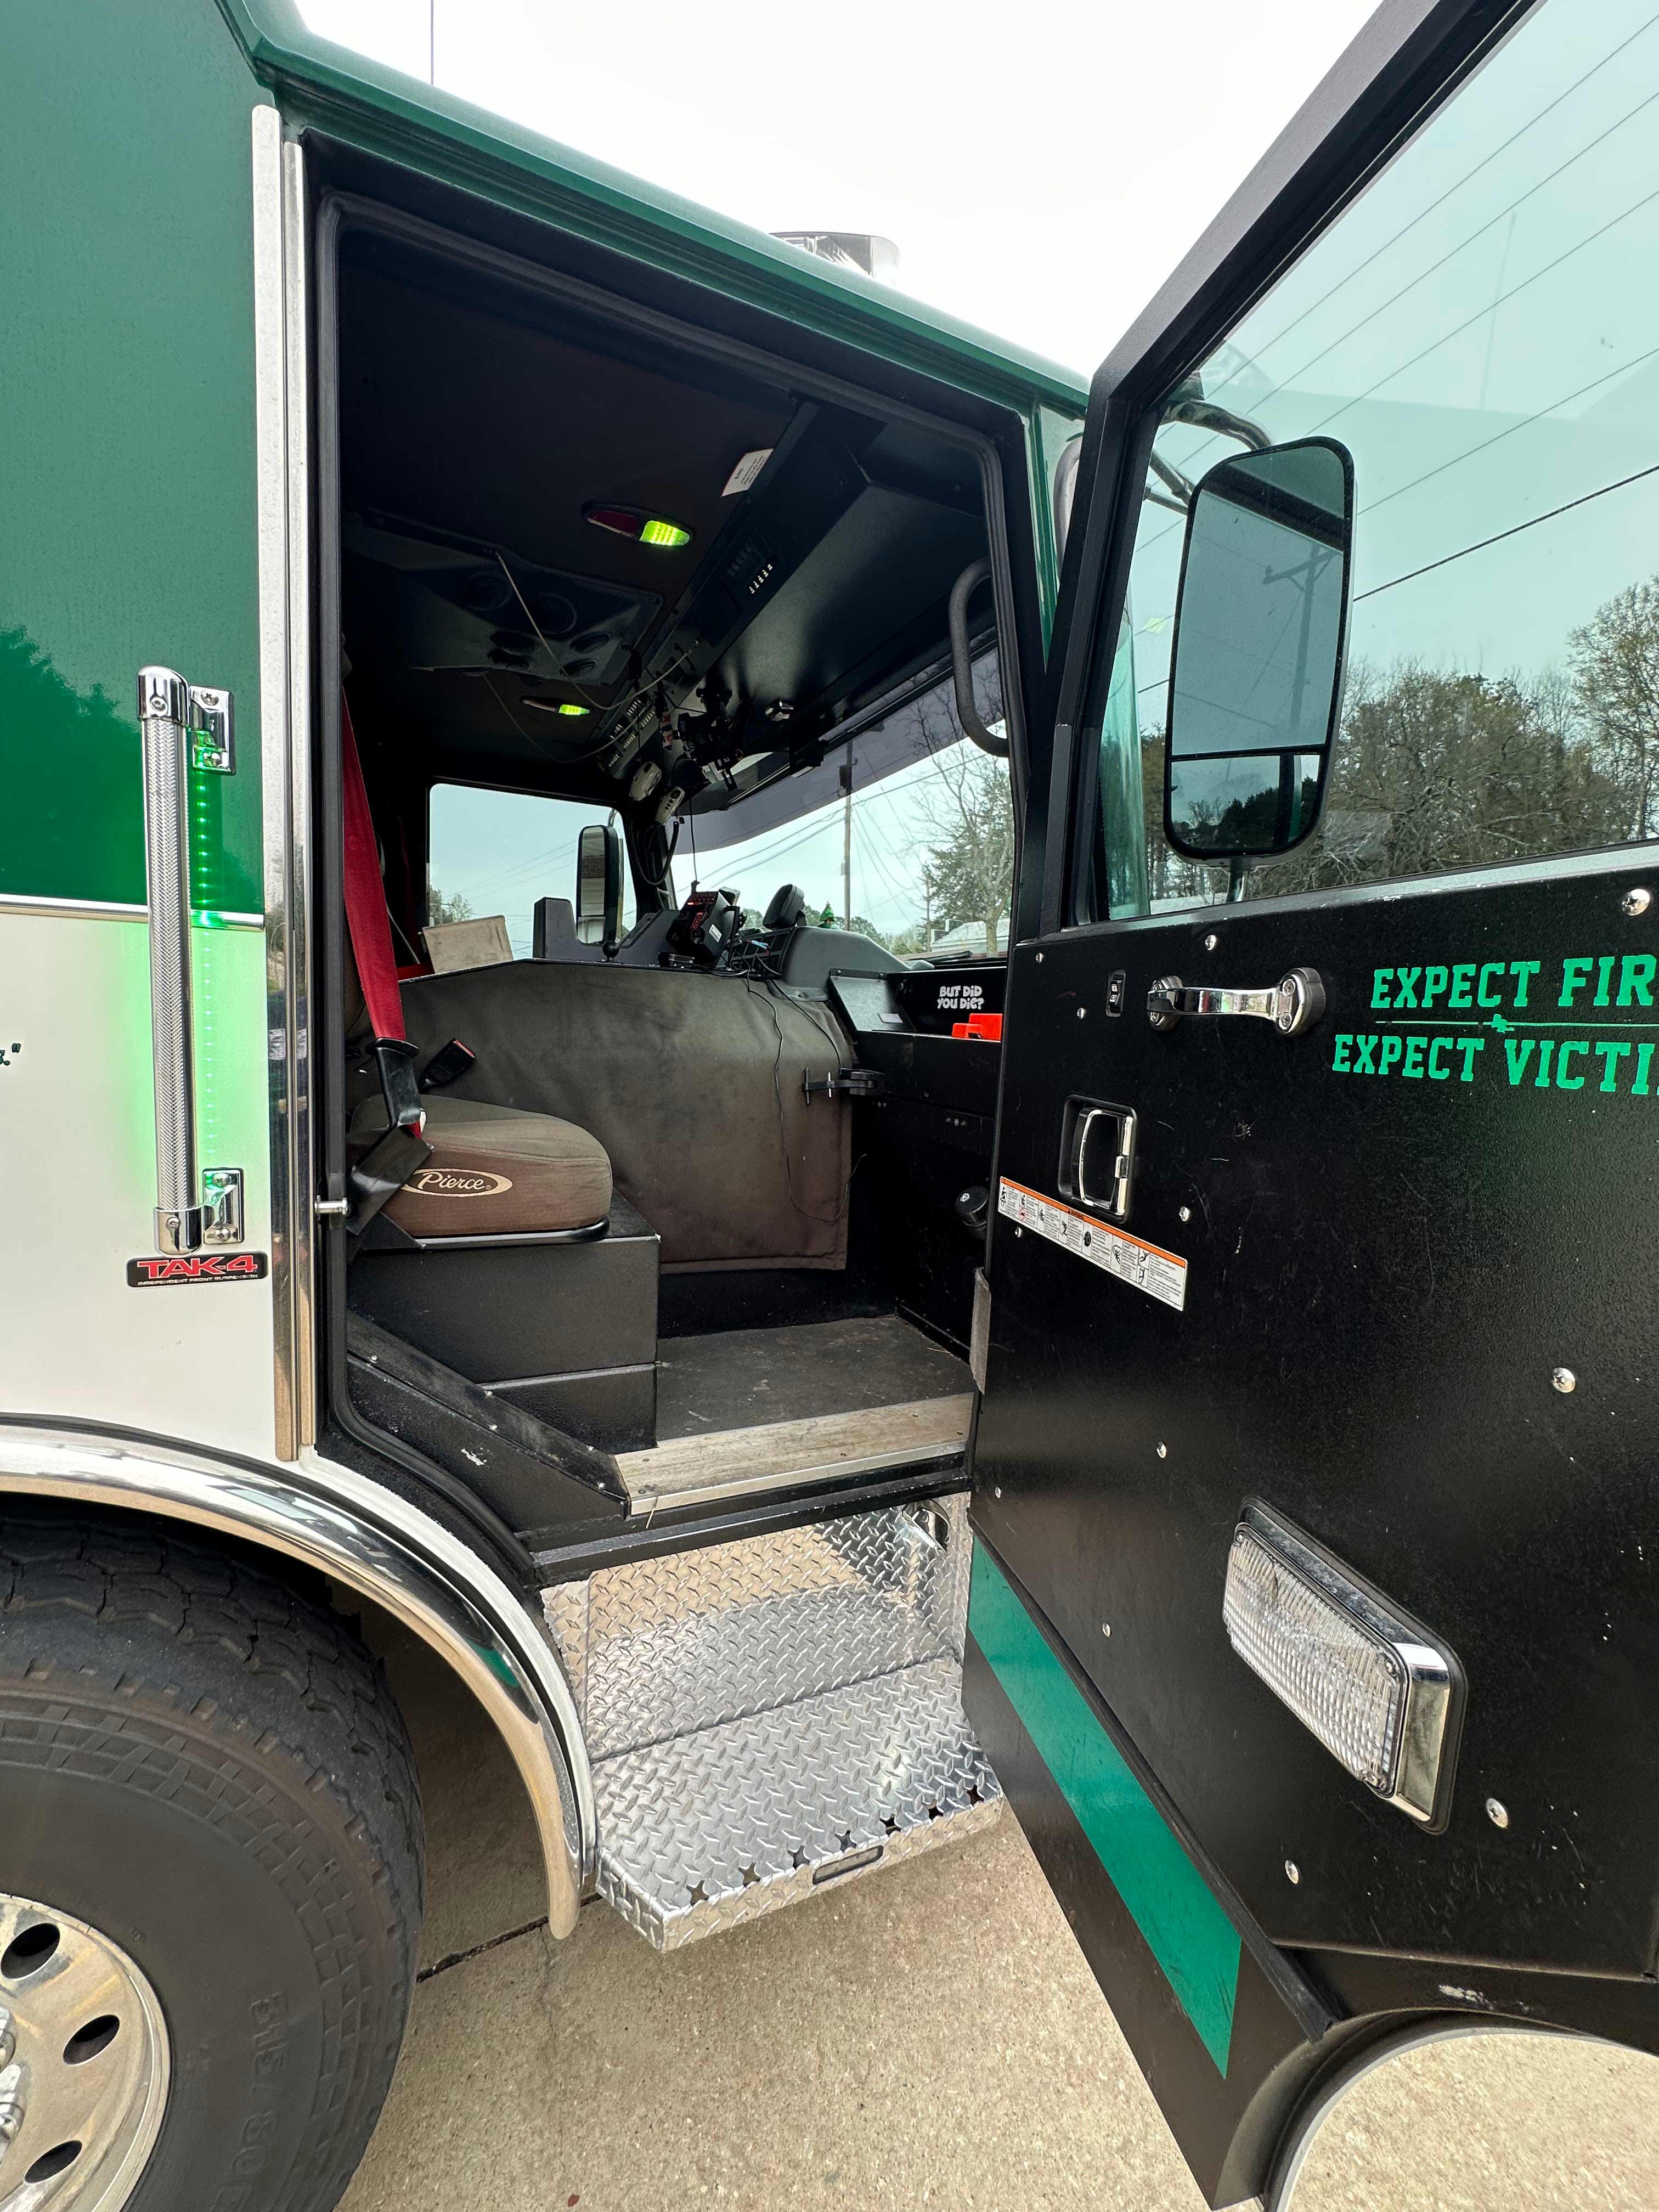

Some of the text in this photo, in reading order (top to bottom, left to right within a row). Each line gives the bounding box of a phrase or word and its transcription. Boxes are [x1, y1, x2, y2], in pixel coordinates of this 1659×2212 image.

[939, 985, 961, 997] BUT
[1370, 954, 1657, 1008] EXPECT FIR
[936, 997, 958, 1009] YOU
[1332, 1034, 1659, 1096] EXPECT VICTI
[417, 1171, 485, 1190] Pierce
[137, 1255, 258, 1279] TAK-4
